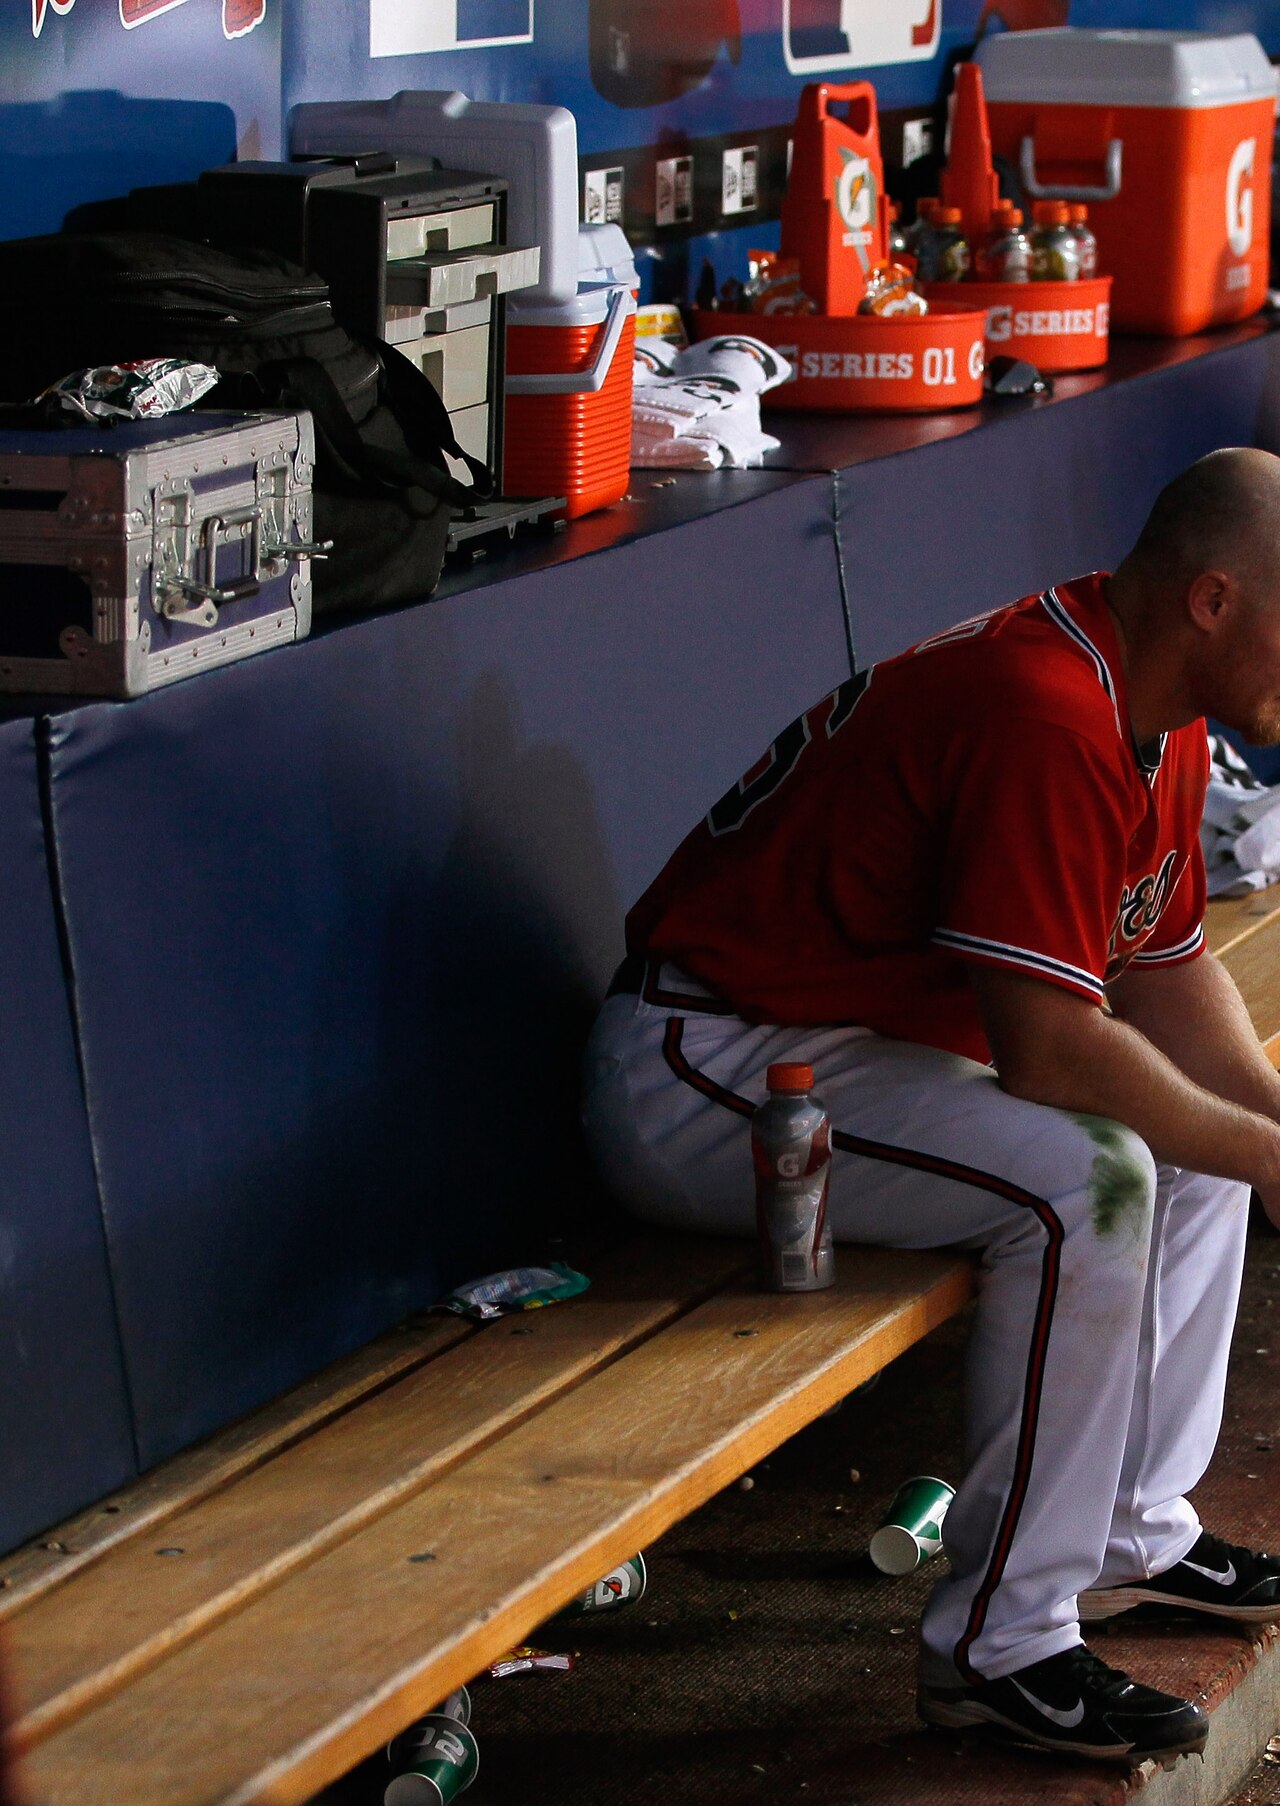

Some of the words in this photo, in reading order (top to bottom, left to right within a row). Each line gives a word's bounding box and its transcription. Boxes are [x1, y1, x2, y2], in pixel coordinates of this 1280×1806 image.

[838, 157, 870, 229] G
[1226, 136, 1257, 257] G
[985, 304, 1013, 342] G
[1014, 309, 1095, 336] SERIES
[801, 352, 914, 380] SERIES
[922, 347, 957, 386] 01
[776, 1152, 800, 1178] G
